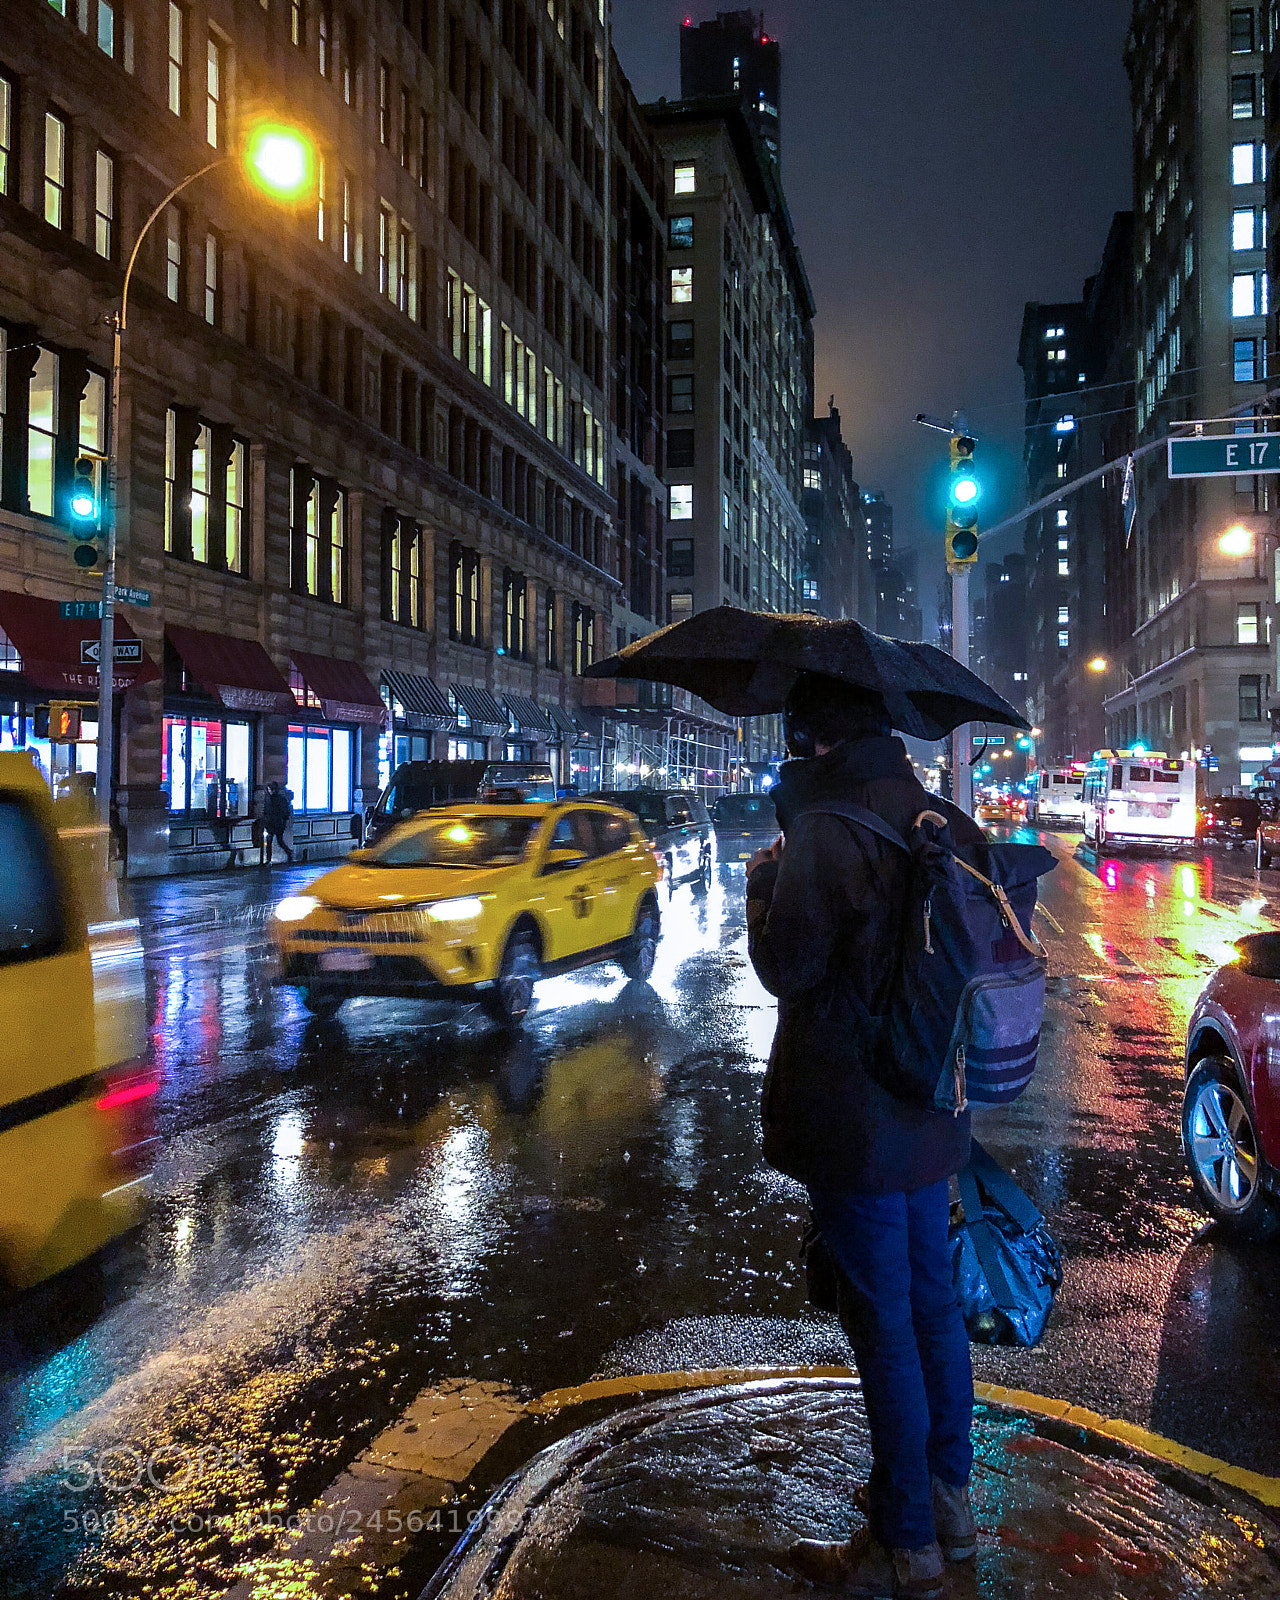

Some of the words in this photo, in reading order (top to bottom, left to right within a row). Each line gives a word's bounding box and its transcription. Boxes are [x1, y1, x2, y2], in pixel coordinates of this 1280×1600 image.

[1226, 443, 1239, 466] E
[1249, 442, 1269, 465] 17
[114, 586, 127, 597] Park
[128, 588, 149, 602] Avenue
[65, 603, 71, 617] E
[75, 603, 85, 616] 17
[117, 646, 136, 656] WAY
[62, 673, 83, 685] THE
